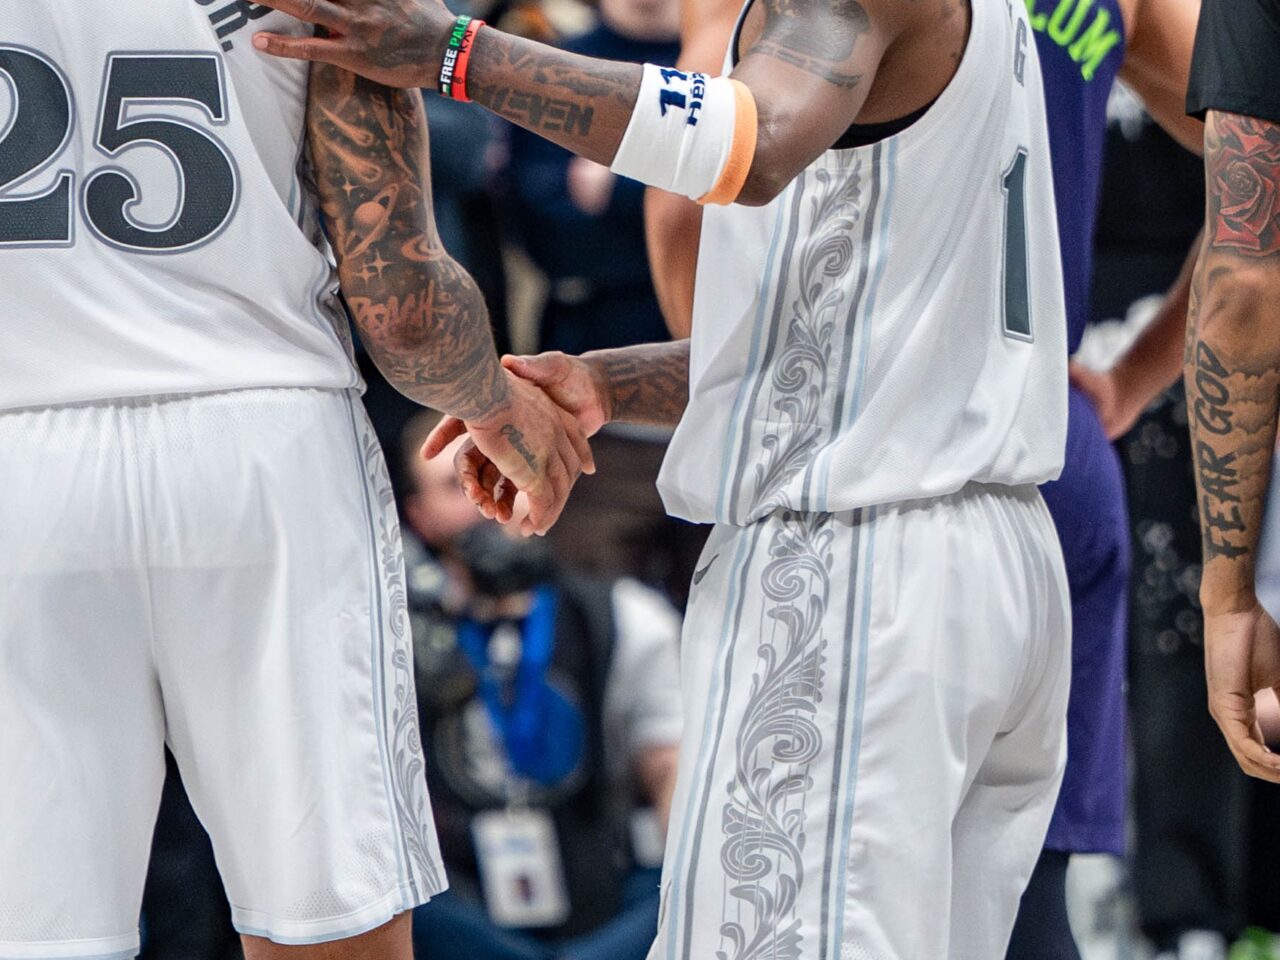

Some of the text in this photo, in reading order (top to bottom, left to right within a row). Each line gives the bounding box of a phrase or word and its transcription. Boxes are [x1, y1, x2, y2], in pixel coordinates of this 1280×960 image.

[440, 48, 458, 84] FREE
[659, 67, 689, 118] 11
[1001, 145, 1034, 344] 1
[1193, 339, 1249, 564] FEAR GOD
